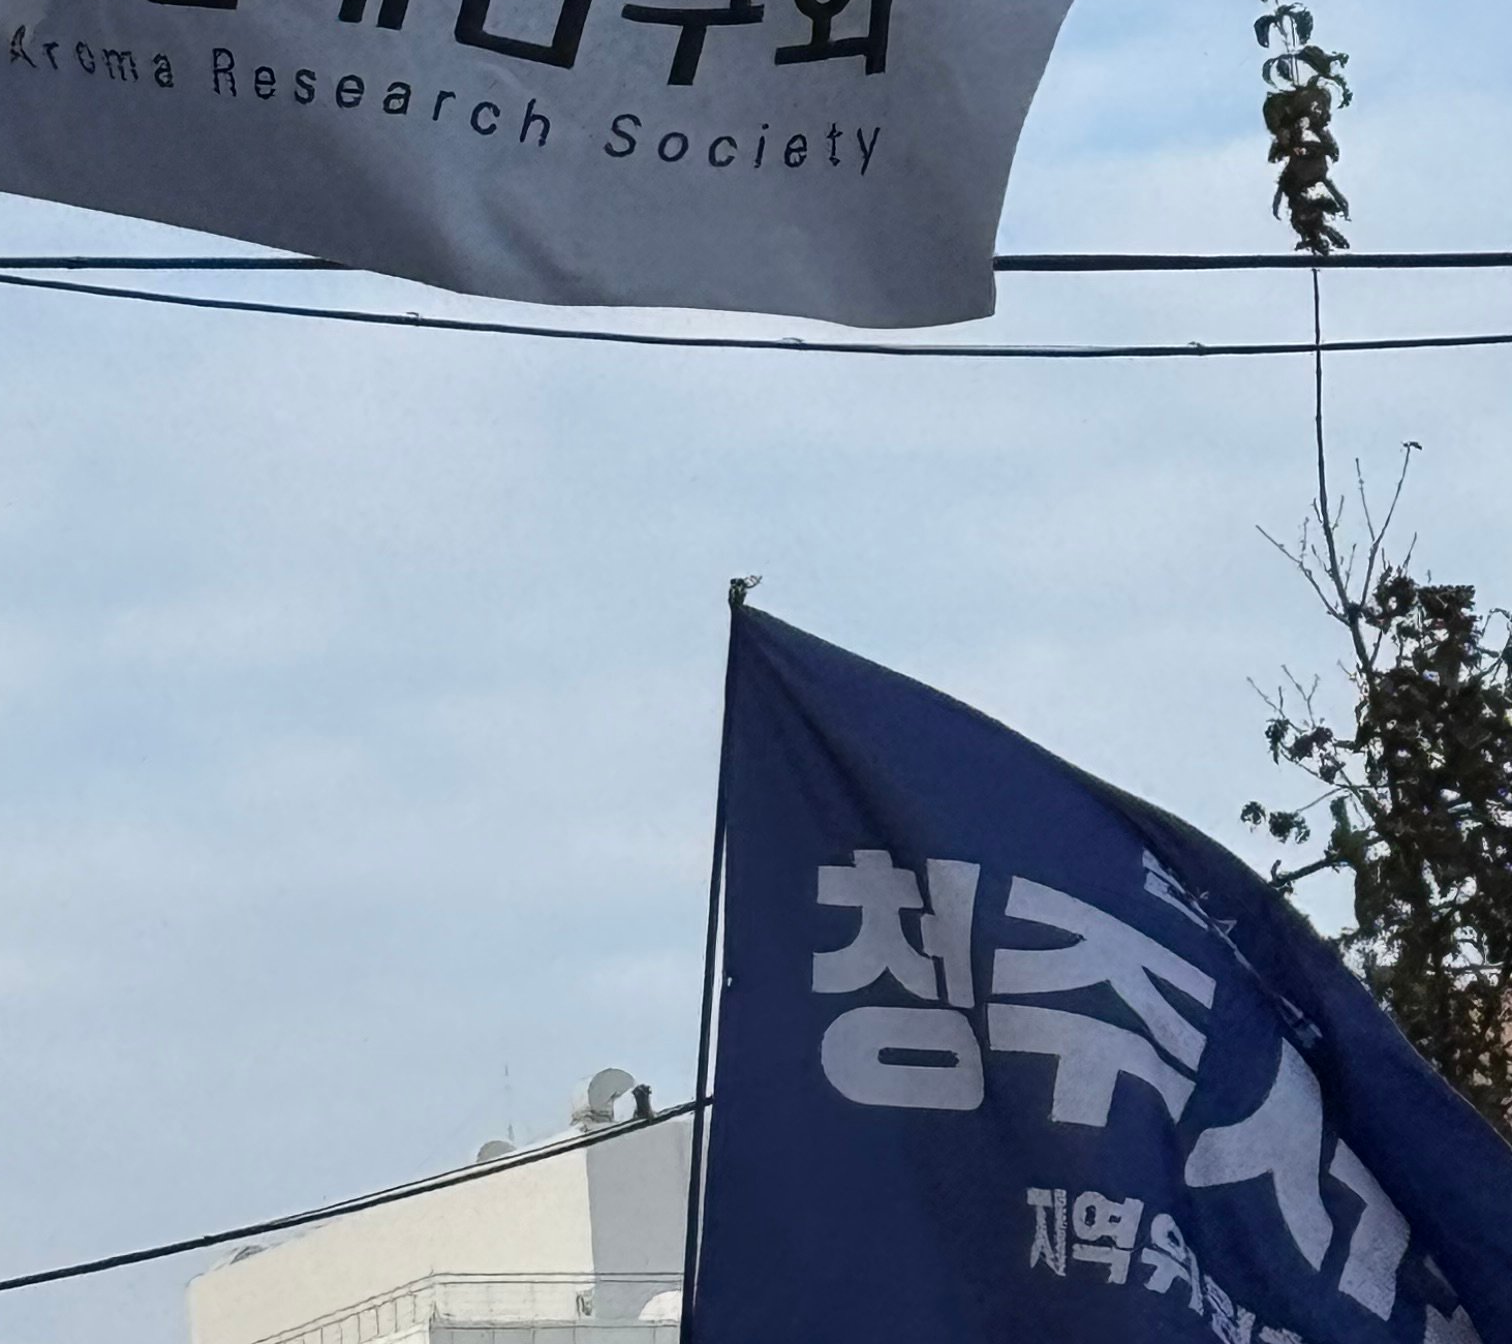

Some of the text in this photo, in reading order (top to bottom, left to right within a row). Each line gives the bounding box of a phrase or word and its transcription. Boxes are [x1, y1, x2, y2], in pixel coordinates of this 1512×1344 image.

[8, 24, 175, 88] Aroma
[211, 47, 553, 147] Research
[603, 112, 883, 177] Society
